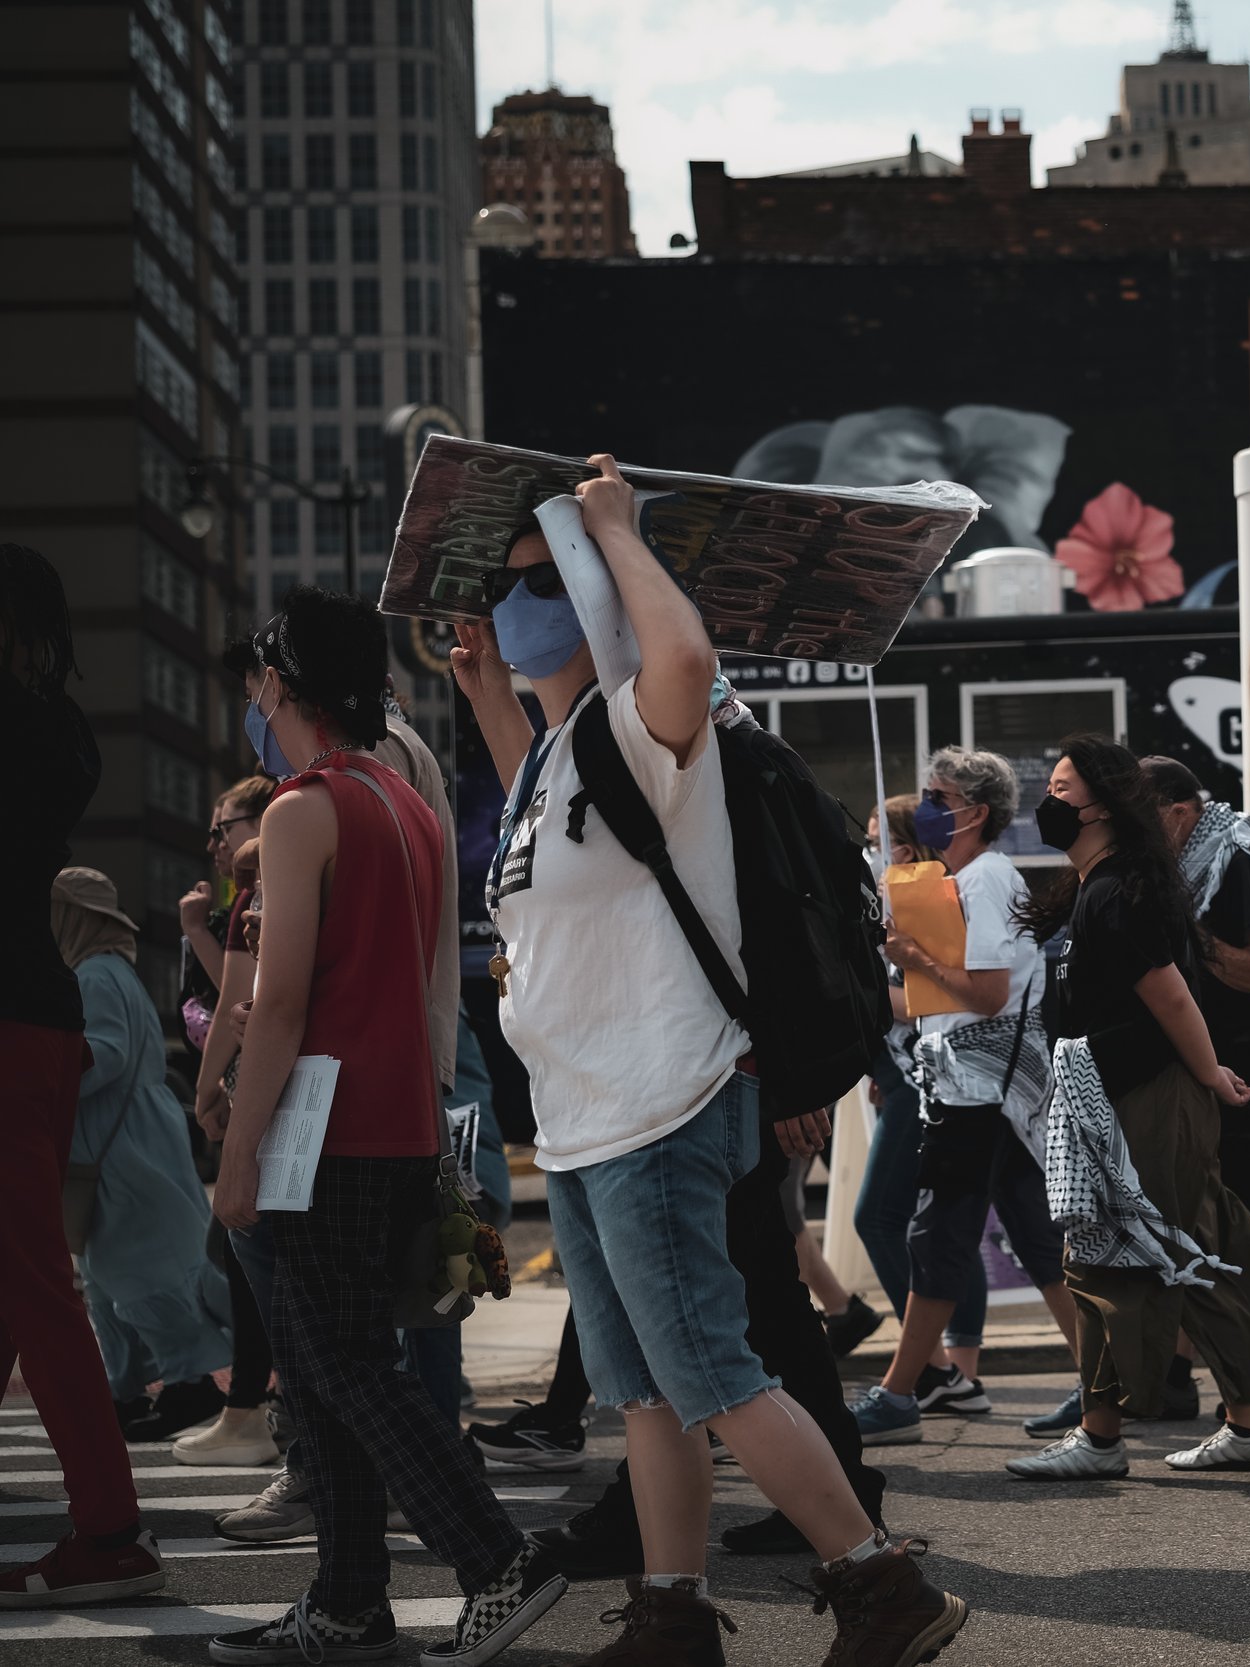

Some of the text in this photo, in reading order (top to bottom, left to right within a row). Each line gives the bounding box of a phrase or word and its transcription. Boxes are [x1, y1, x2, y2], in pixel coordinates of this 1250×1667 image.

[700, 491, 843, 648] GENOCIDE
[773, 503, 950, 658] STOP the
